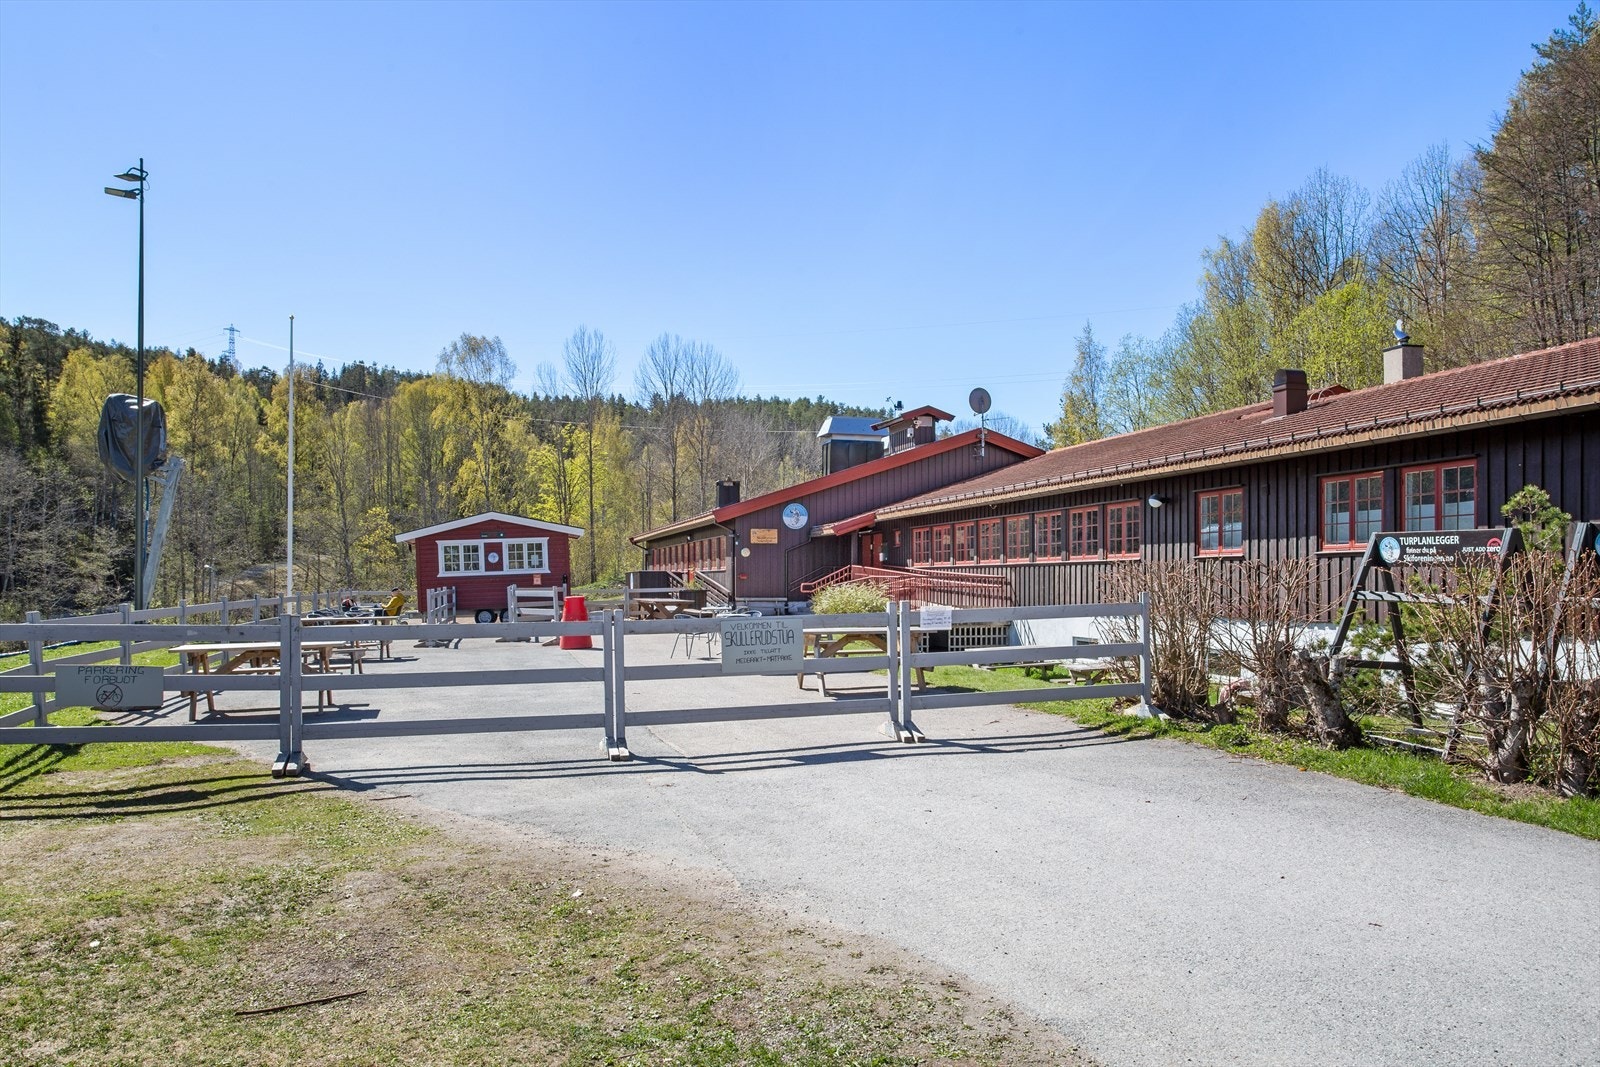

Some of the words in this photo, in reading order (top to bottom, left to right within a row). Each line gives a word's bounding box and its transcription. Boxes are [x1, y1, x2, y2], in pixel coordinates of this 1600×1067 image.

[1400, 536, 1460, 545] TURPLANLEGGER
[1430, 546, 1437, 555] på
[730, 622, 772, 630] VELKOMMEN
[724, 629, 795, 647] SKULLERUDSTUA
[78, 666, 144, 675] PARKERING
[84, 675, 138, 684] FORBUDT
